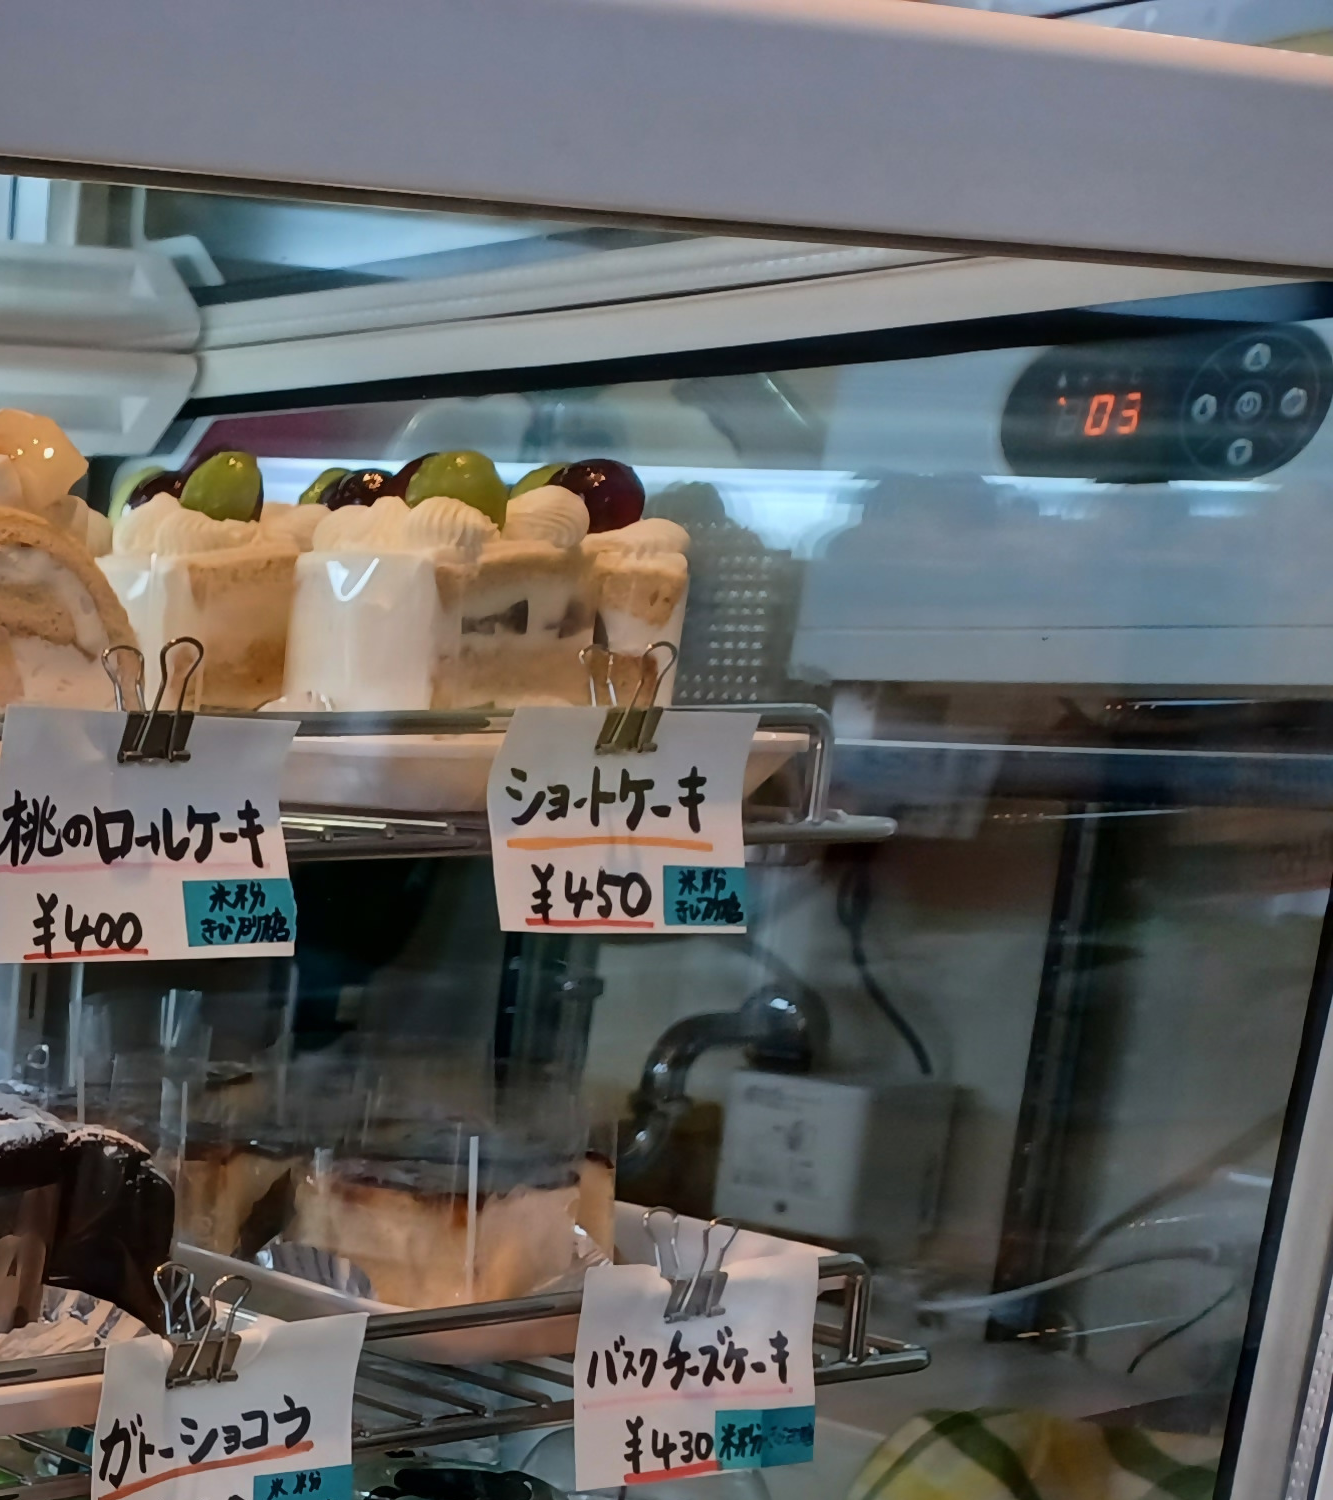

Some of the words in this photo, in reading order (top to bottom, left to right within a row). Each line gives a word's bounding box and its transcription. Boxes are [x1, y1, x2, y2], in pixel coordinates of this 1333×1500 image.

[505, 765, 707, 834] ショートケーキ
[209, 881, 266, 913] 米粉
[530, 862, 652, 924] ¥450
[32, 893, 143, 958] ¥400
[586, 1326, 790, 1390] バスクチーズケーキ
[99, 1394, 311, 1489] ガトーショコラ
[623, 1415, 714, 1474] ¥430
[267, 1471, 322, 1500] 米粉
